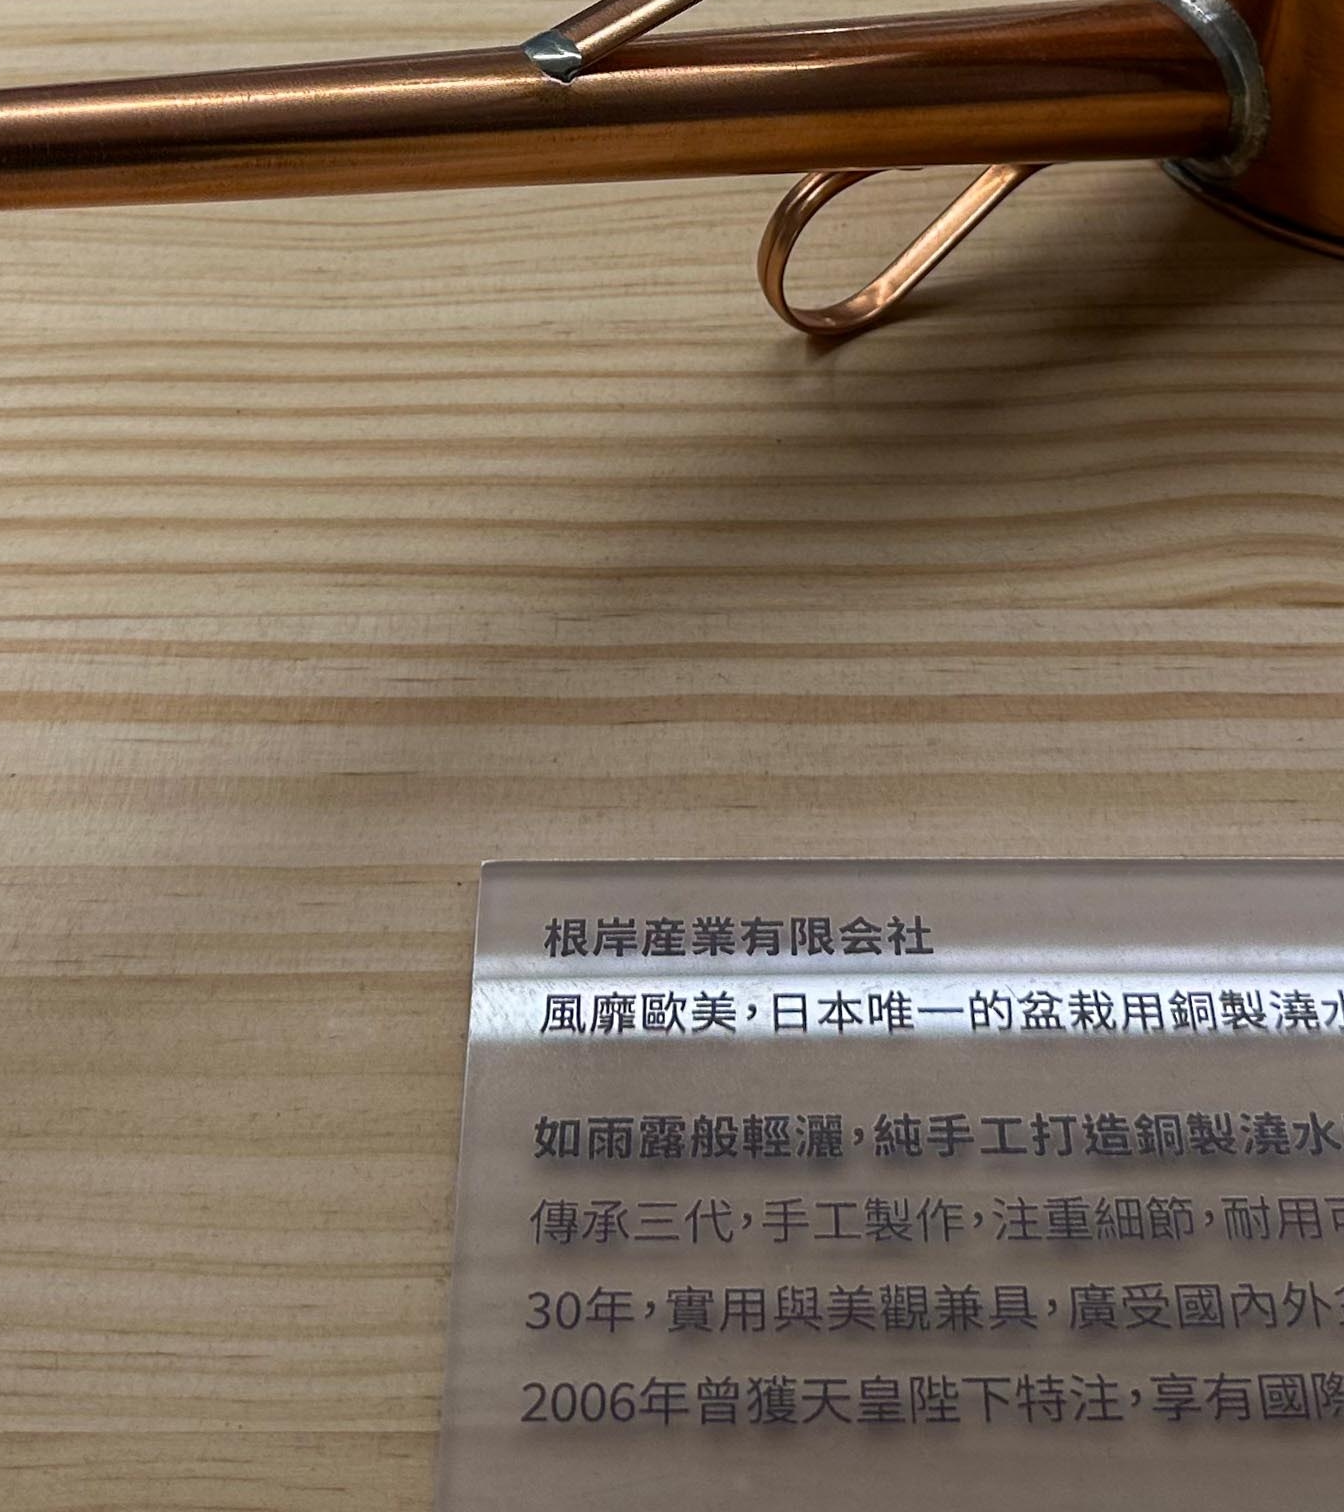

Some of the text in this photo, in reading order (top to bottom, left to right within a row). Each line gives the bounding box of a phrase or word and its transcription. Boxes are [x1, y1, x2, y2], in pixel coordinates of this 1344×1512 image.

[543, 915, 935, 958] 根岸産業有限会社
